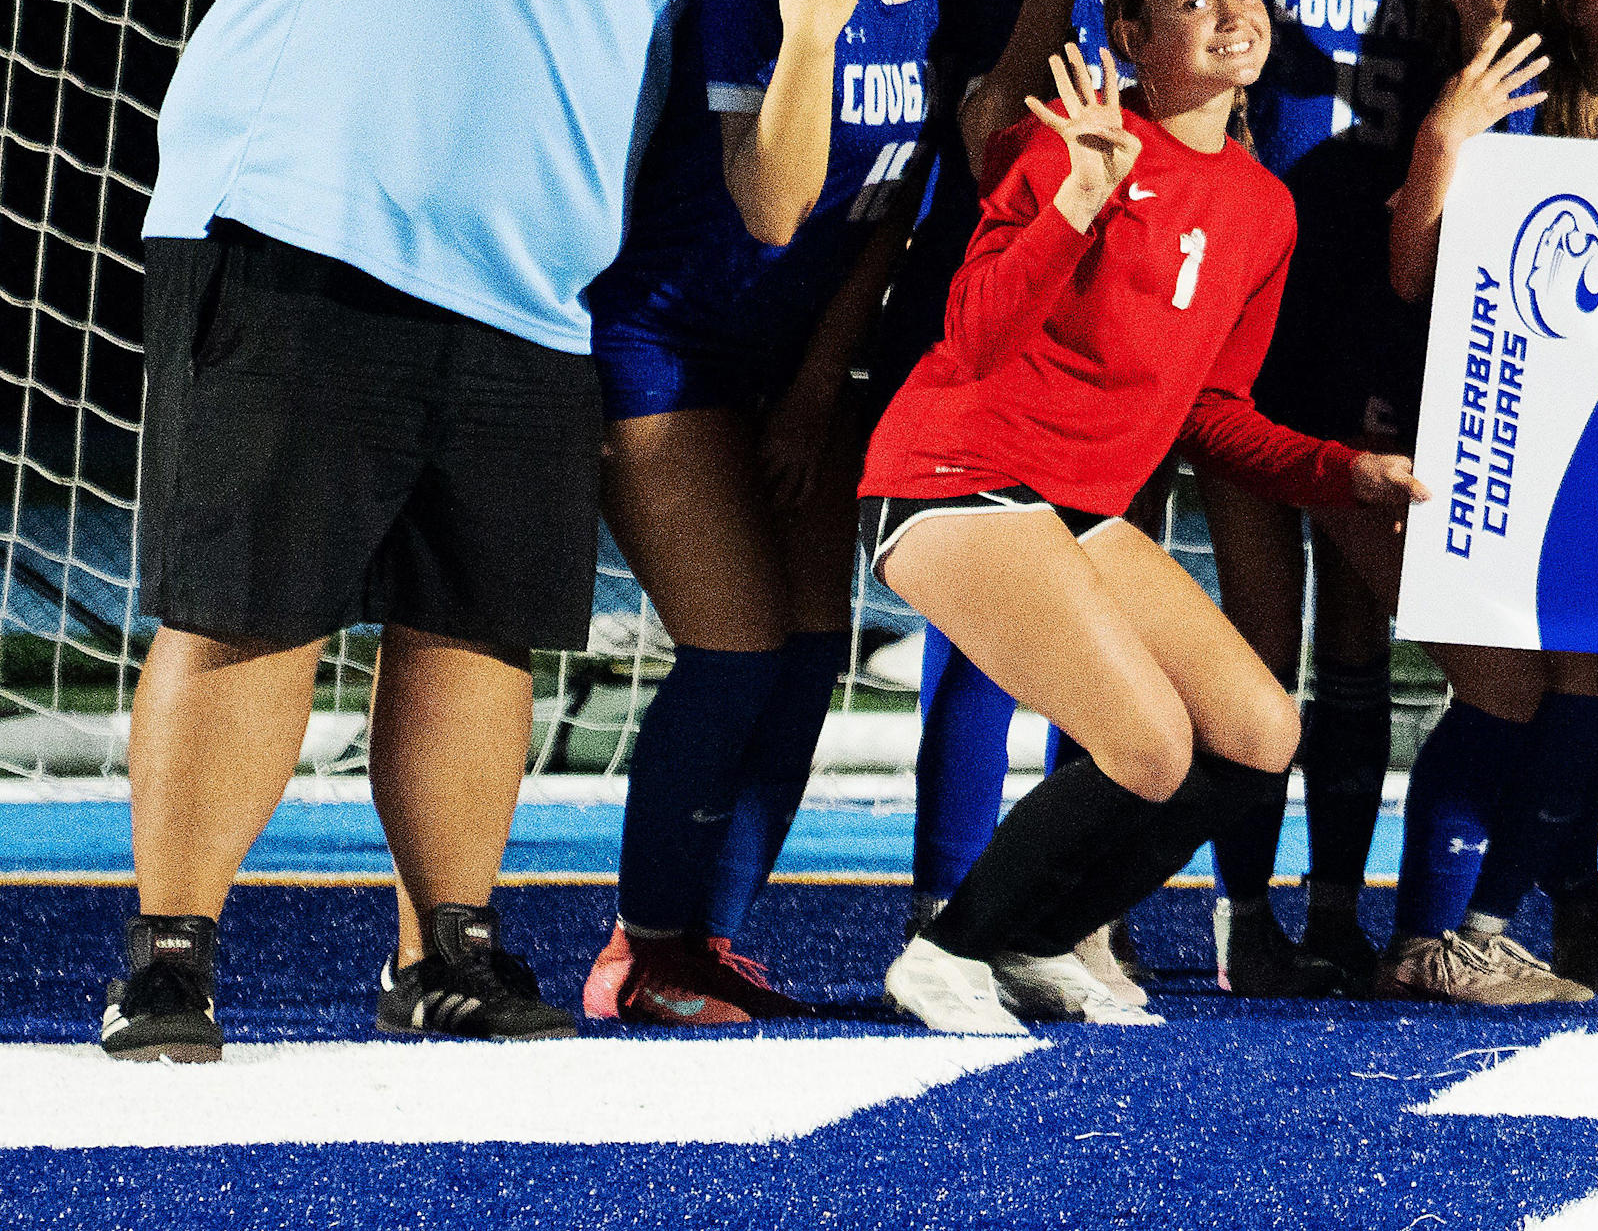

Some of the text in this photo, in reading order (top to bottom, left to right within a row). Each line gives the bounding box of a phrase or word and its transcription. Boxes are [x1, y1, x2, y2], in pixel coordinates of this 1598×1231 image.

[1171, 227, 1206, 310] 1
[1446, 265, 1501, 560] CANTERBURY
[1482, 330, 1528, 538] COUGARS
